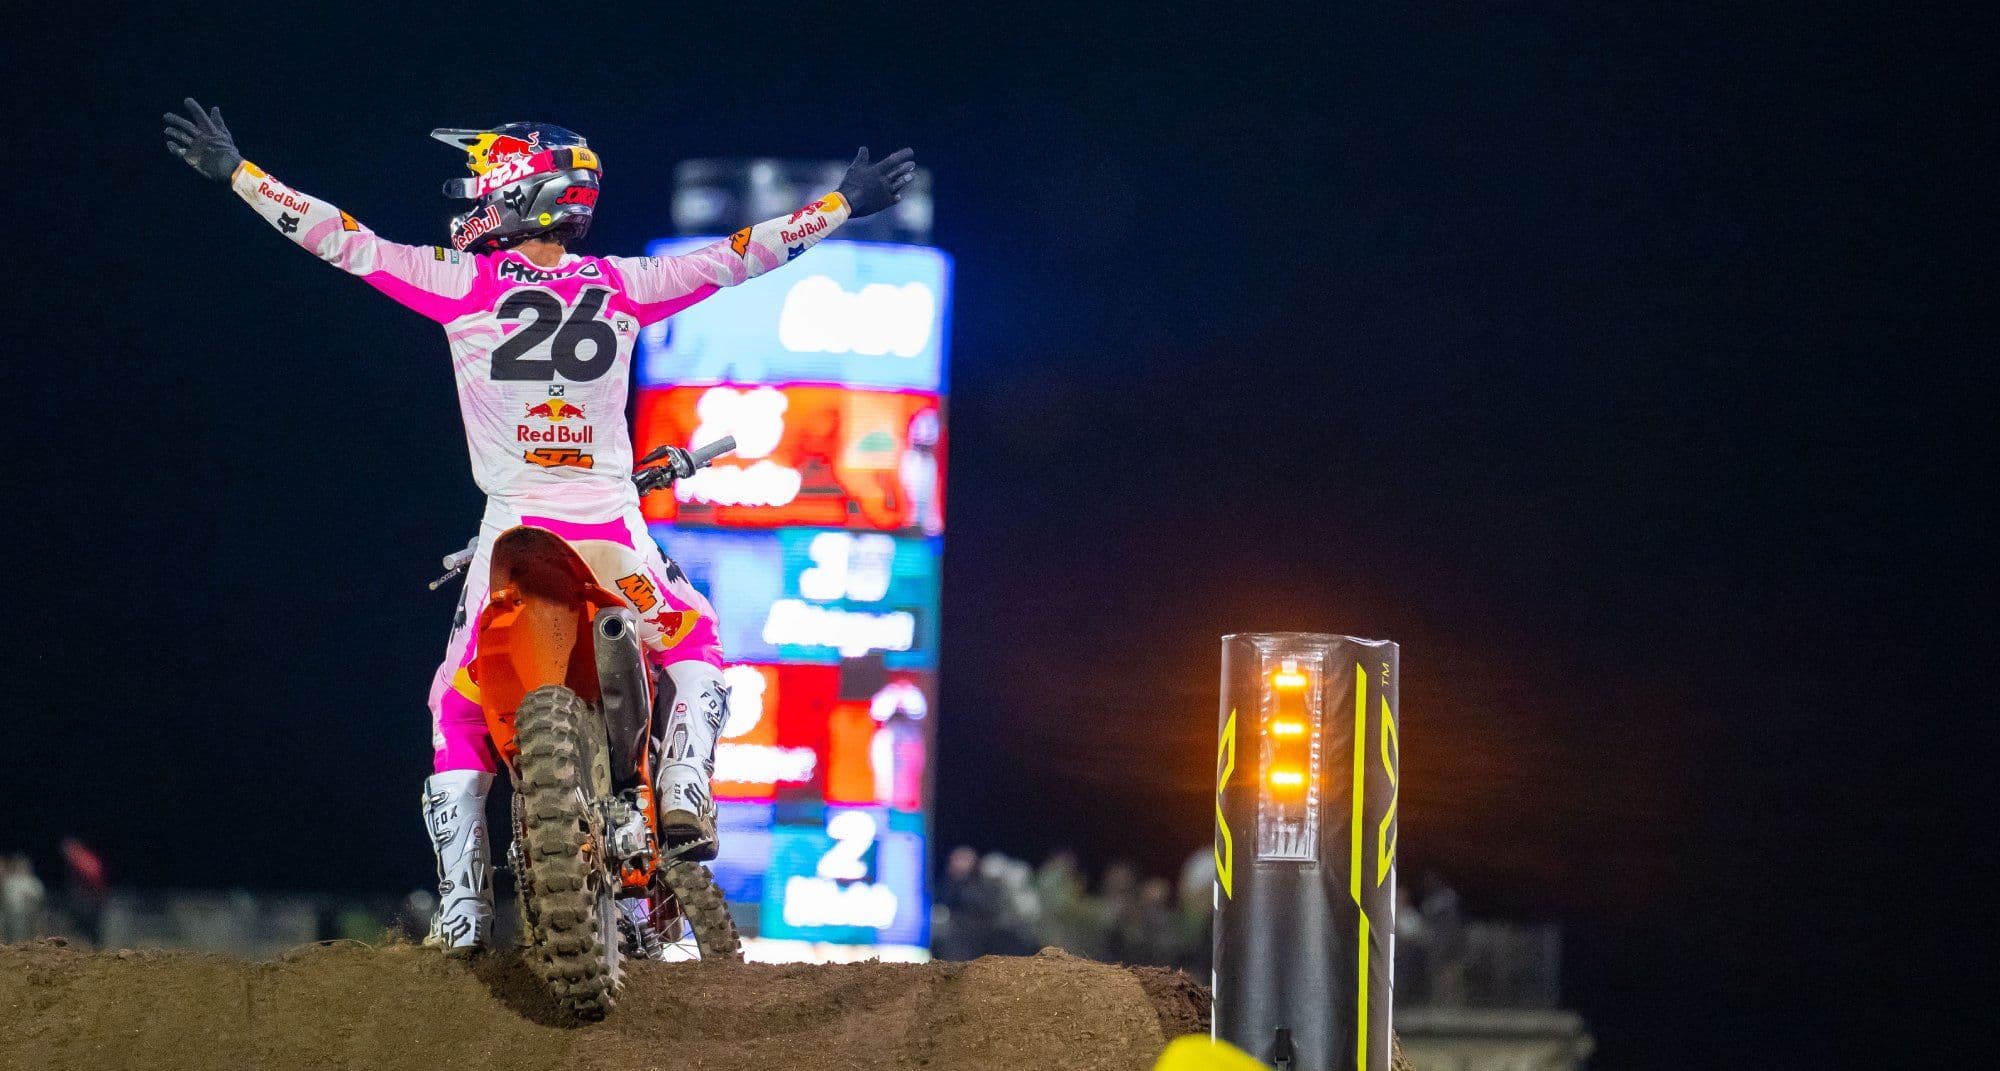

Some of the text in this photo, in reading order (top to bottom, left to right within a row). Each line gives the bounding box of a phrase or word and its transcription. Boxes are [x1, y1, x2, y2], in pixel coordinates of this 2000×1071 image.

[258, 181, 310, 215] Red Bull
[452, 205, 501, 251] Red Bull
[780, 215, 828, 245] Red Bull
[490, 288, 618, 383] 26
[516, 424, 593, 444] Red Bull
[615, 573, 658, 614] KTM
[1381, 662, 1390, 687] TM
[434, 805, 458, 831] FOX
[816, 810, 876, 881] 2
